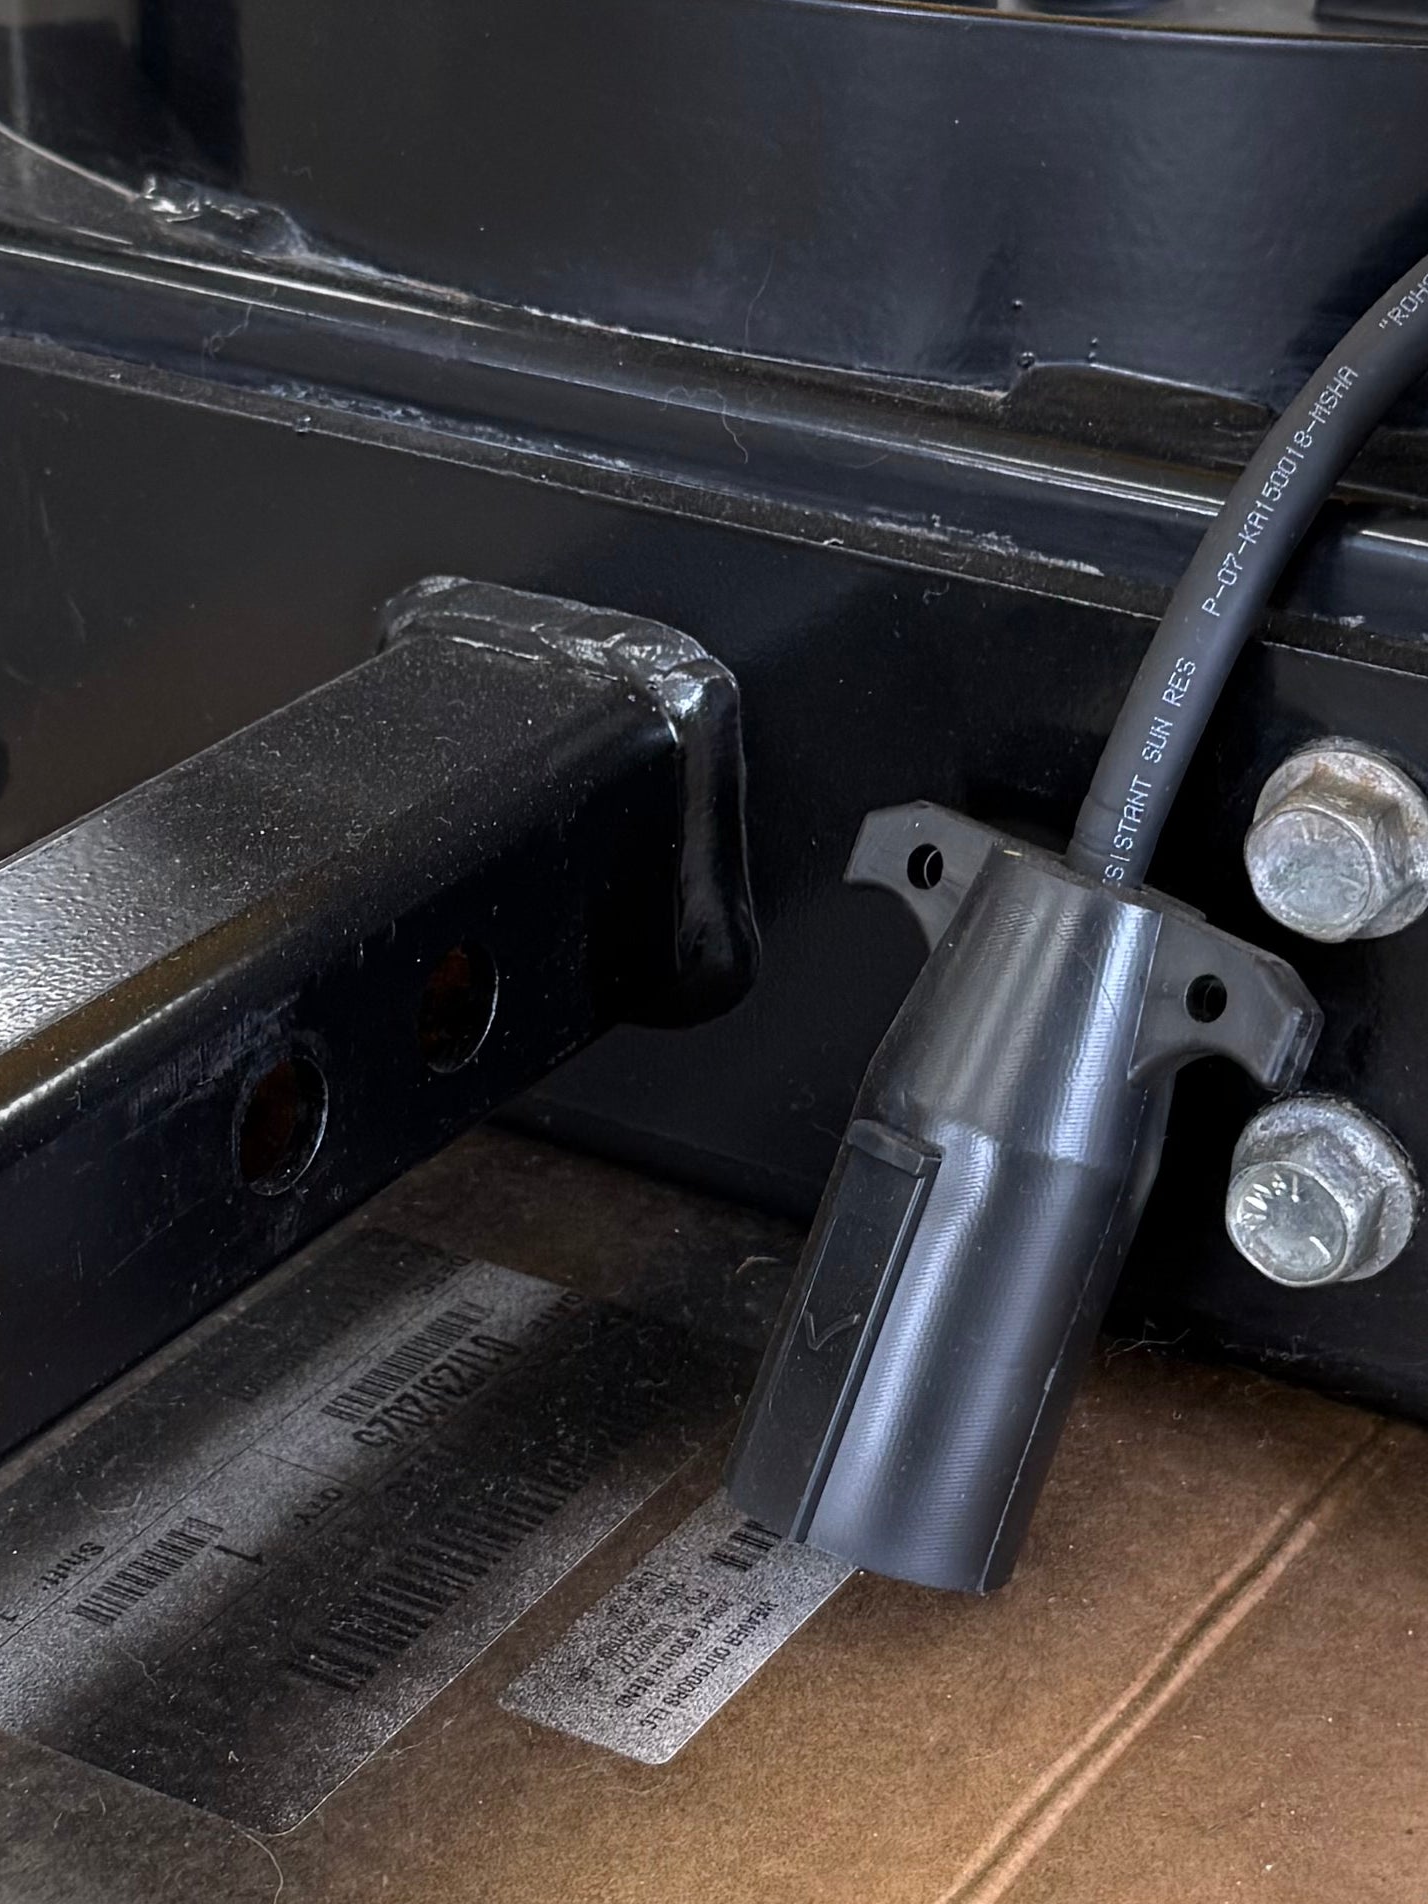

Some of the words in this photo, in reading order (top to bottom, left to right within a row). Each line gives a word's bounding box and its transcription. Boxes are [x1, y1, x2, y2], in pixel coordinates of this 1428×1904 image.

[1103, 774, 1152, 887] SISTANT
[1141, 716, 1173, 764] SUN
[1162, 656, 1197, 707] RES
[352, 1334, 521, 1449] 01/23/2025
